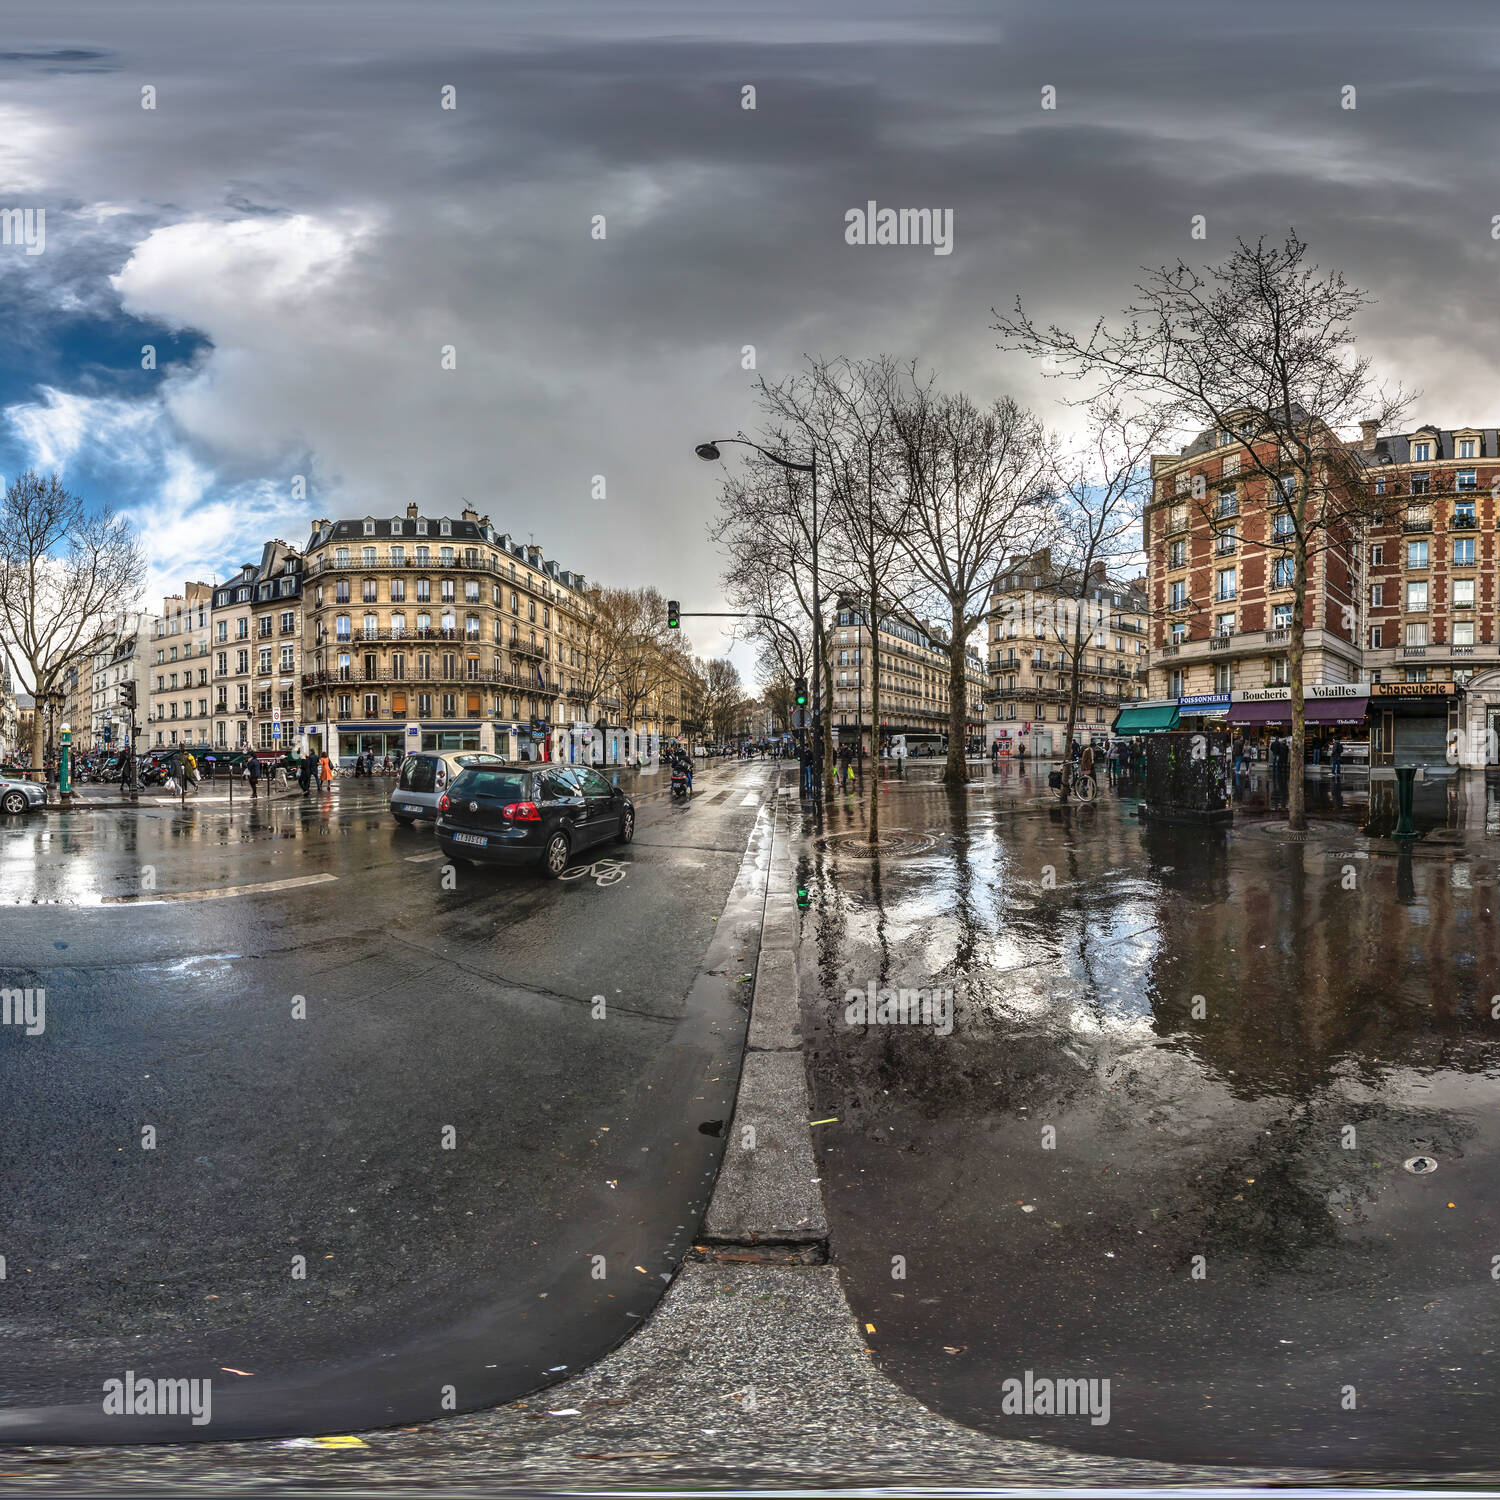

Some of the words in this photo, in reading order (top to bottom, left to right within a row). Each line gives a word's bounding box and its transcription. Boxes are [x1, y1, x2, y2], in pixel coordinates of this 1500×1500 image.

[1312, 686, 1357, 697] Volailles
[1379, 684, 1446, 694] Charcuterie
[1180, 694, 1229, 704] POISSONNERIE
[1242, 689, 1288, 700] Boucherie
